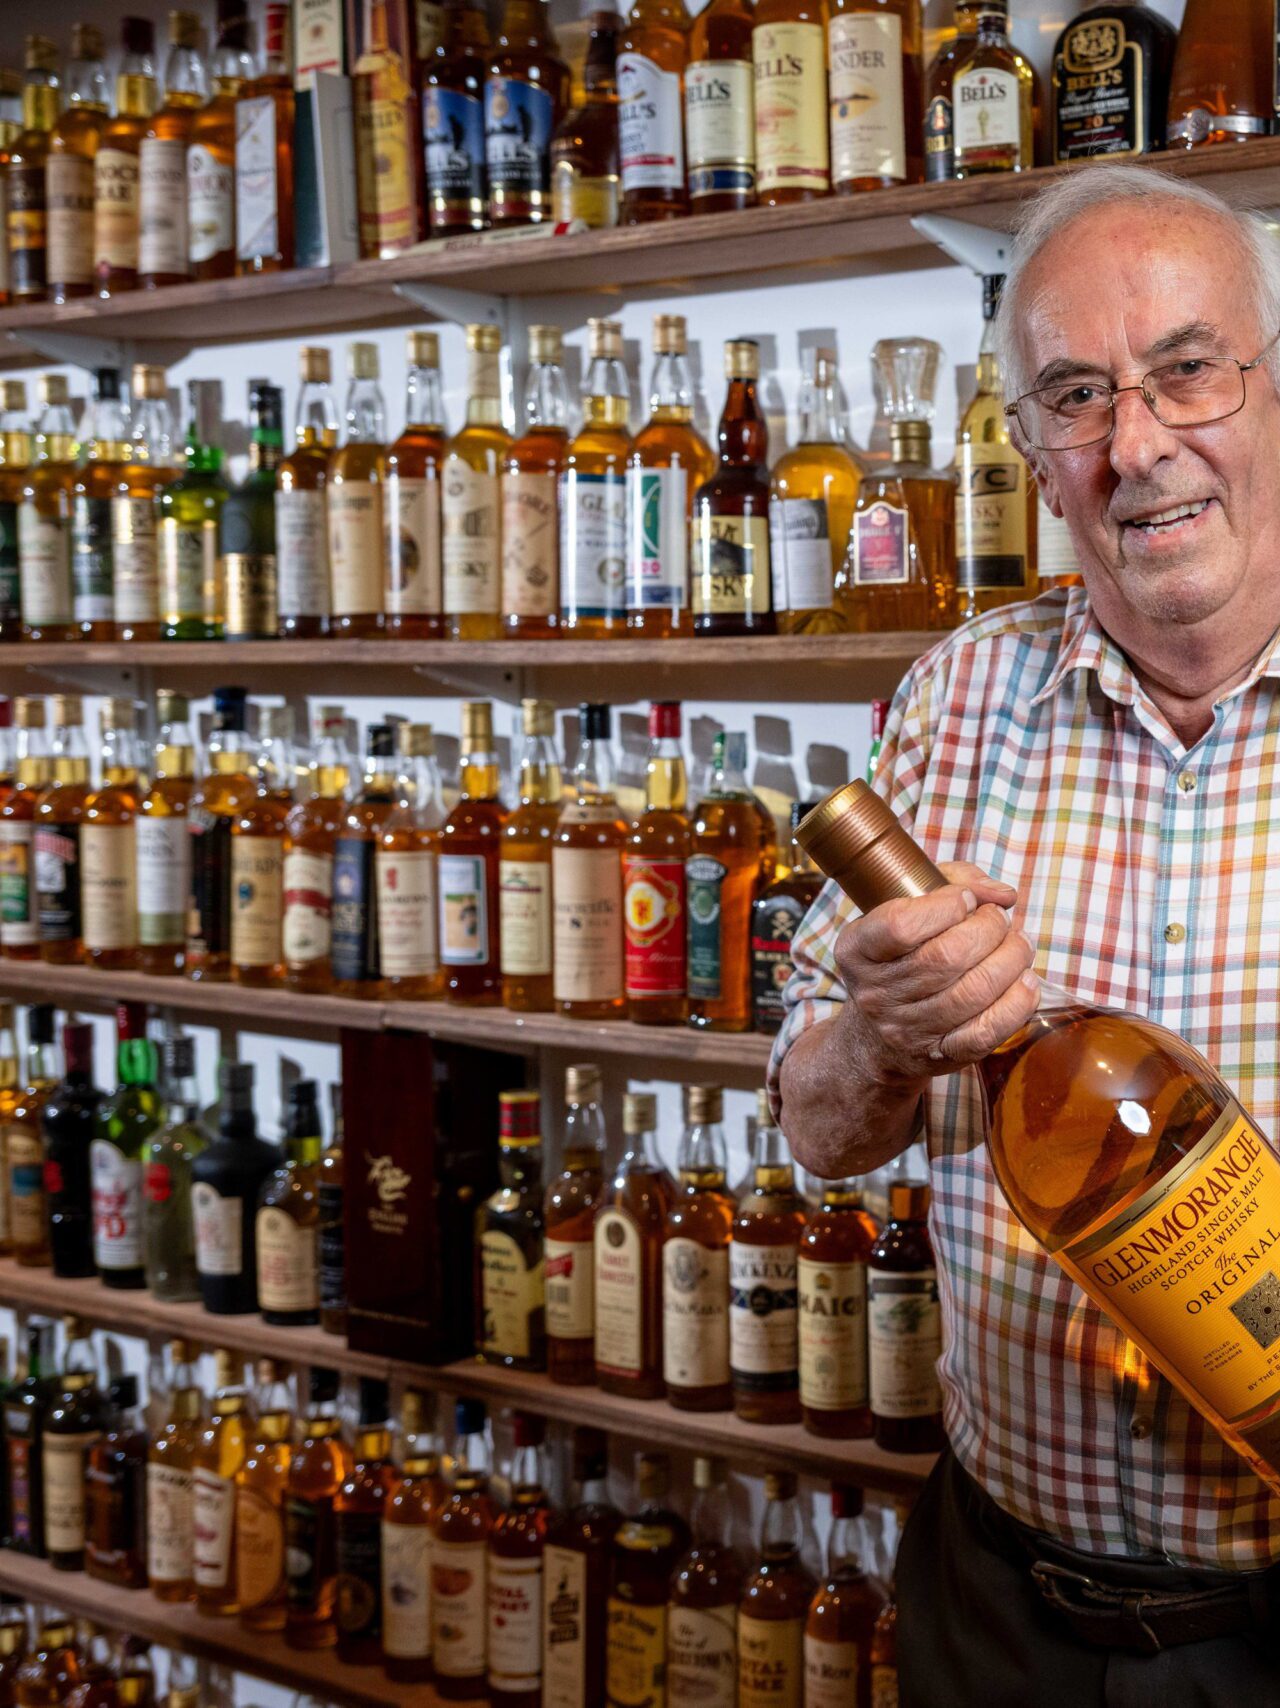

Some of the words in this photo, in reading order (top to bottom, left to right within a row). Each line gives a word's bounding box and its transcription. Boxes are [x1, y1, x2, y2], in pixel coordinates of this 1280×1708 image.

[756, 54, 804, 81] ELL'S
[1067, 69, 1123, 91] BELL'S
[687, 78, 731, 104] ELL'S
[961, 83, 1007, 103] BELL'S
[1091, 1129, 1262, 1288] GLENMORANGIE
[1128, 1241, 1198, 1294] HIGHLAND
[1198, 1197, 1242, 1242] SINGLE
[1242, 1167, 1265, 1199] MALT
[1160, 1245, 1214, 1291] SCOTCH
[1216, 1197, 1261, 1244] WHISKY
[1213, 1250, 1238, 1272] The
[1247, 1380, 1258, 1392] BY
[1258, 1368, 1275, 1384] THE
